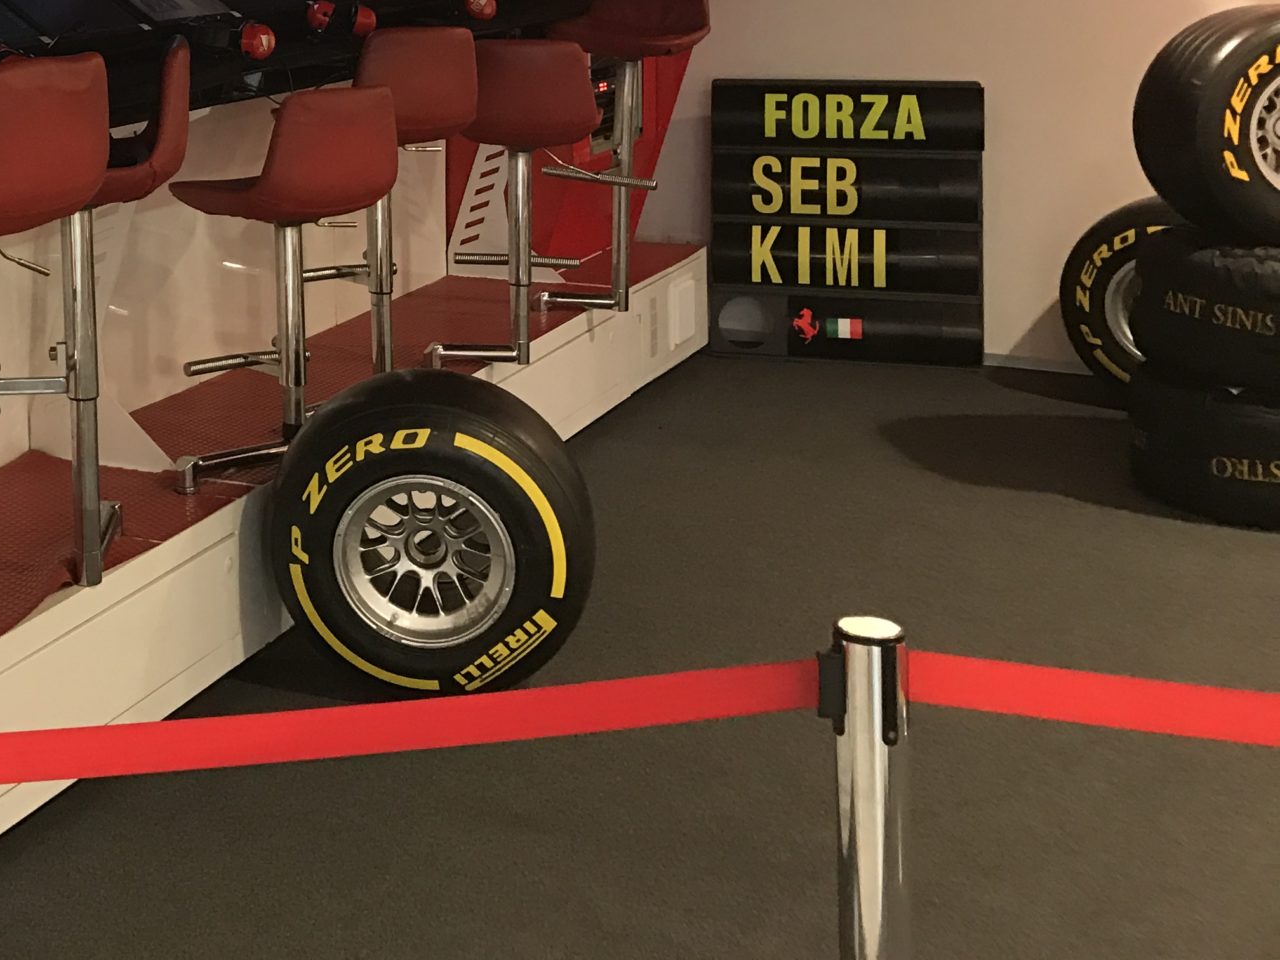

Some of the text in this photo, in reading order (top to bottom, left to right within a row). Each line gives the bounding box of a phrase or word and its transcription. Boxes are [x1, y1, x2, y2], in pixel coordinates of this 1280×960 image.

[764, 93, 926, 140] FORZA
[1223, 44, 1280, 181] P ZER
[751, 155, 858, 215] SEB
[751, 225, 886, 287] KIMI
[1076, 228, 1136, 345] P ZERO
[1163, 290, 1276, 337] ANT SINIS
[291, 428, 431, 564] P ZERO
[453, 609, 558, 690] PIRELLI
